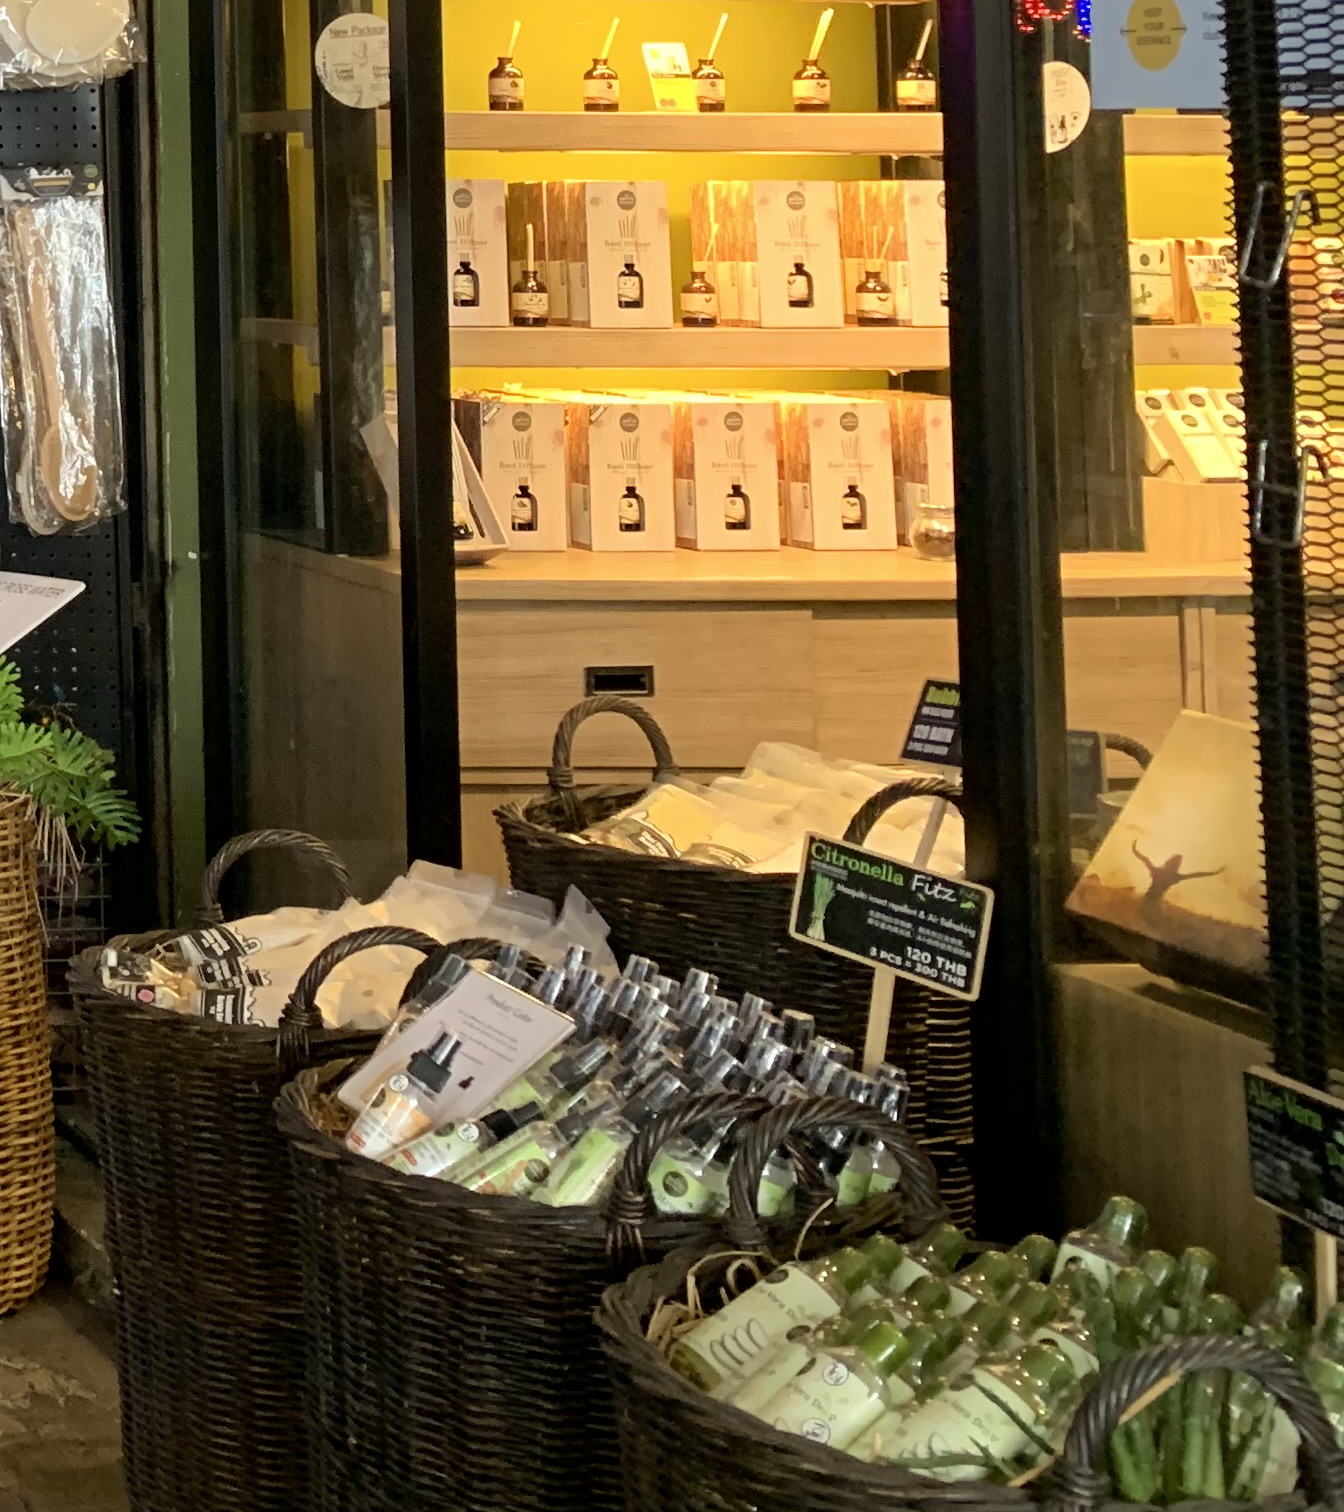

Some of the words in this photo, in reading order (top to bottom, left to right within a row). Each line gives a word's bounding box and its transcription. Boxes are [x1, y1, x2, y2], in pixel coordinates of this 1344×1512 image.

[7, 580, 32, 595] ROSE
[29, 584, 66, 600] WATER
[811, 841, 905, 887] Citronella
[912, 873, 958, 903] Fitz
[880, 950, 903, 966] PCS
[941, 971, 966, 988] THB
[906, 946, 932, 964] 120
[936, 955, 967, 977] THB
